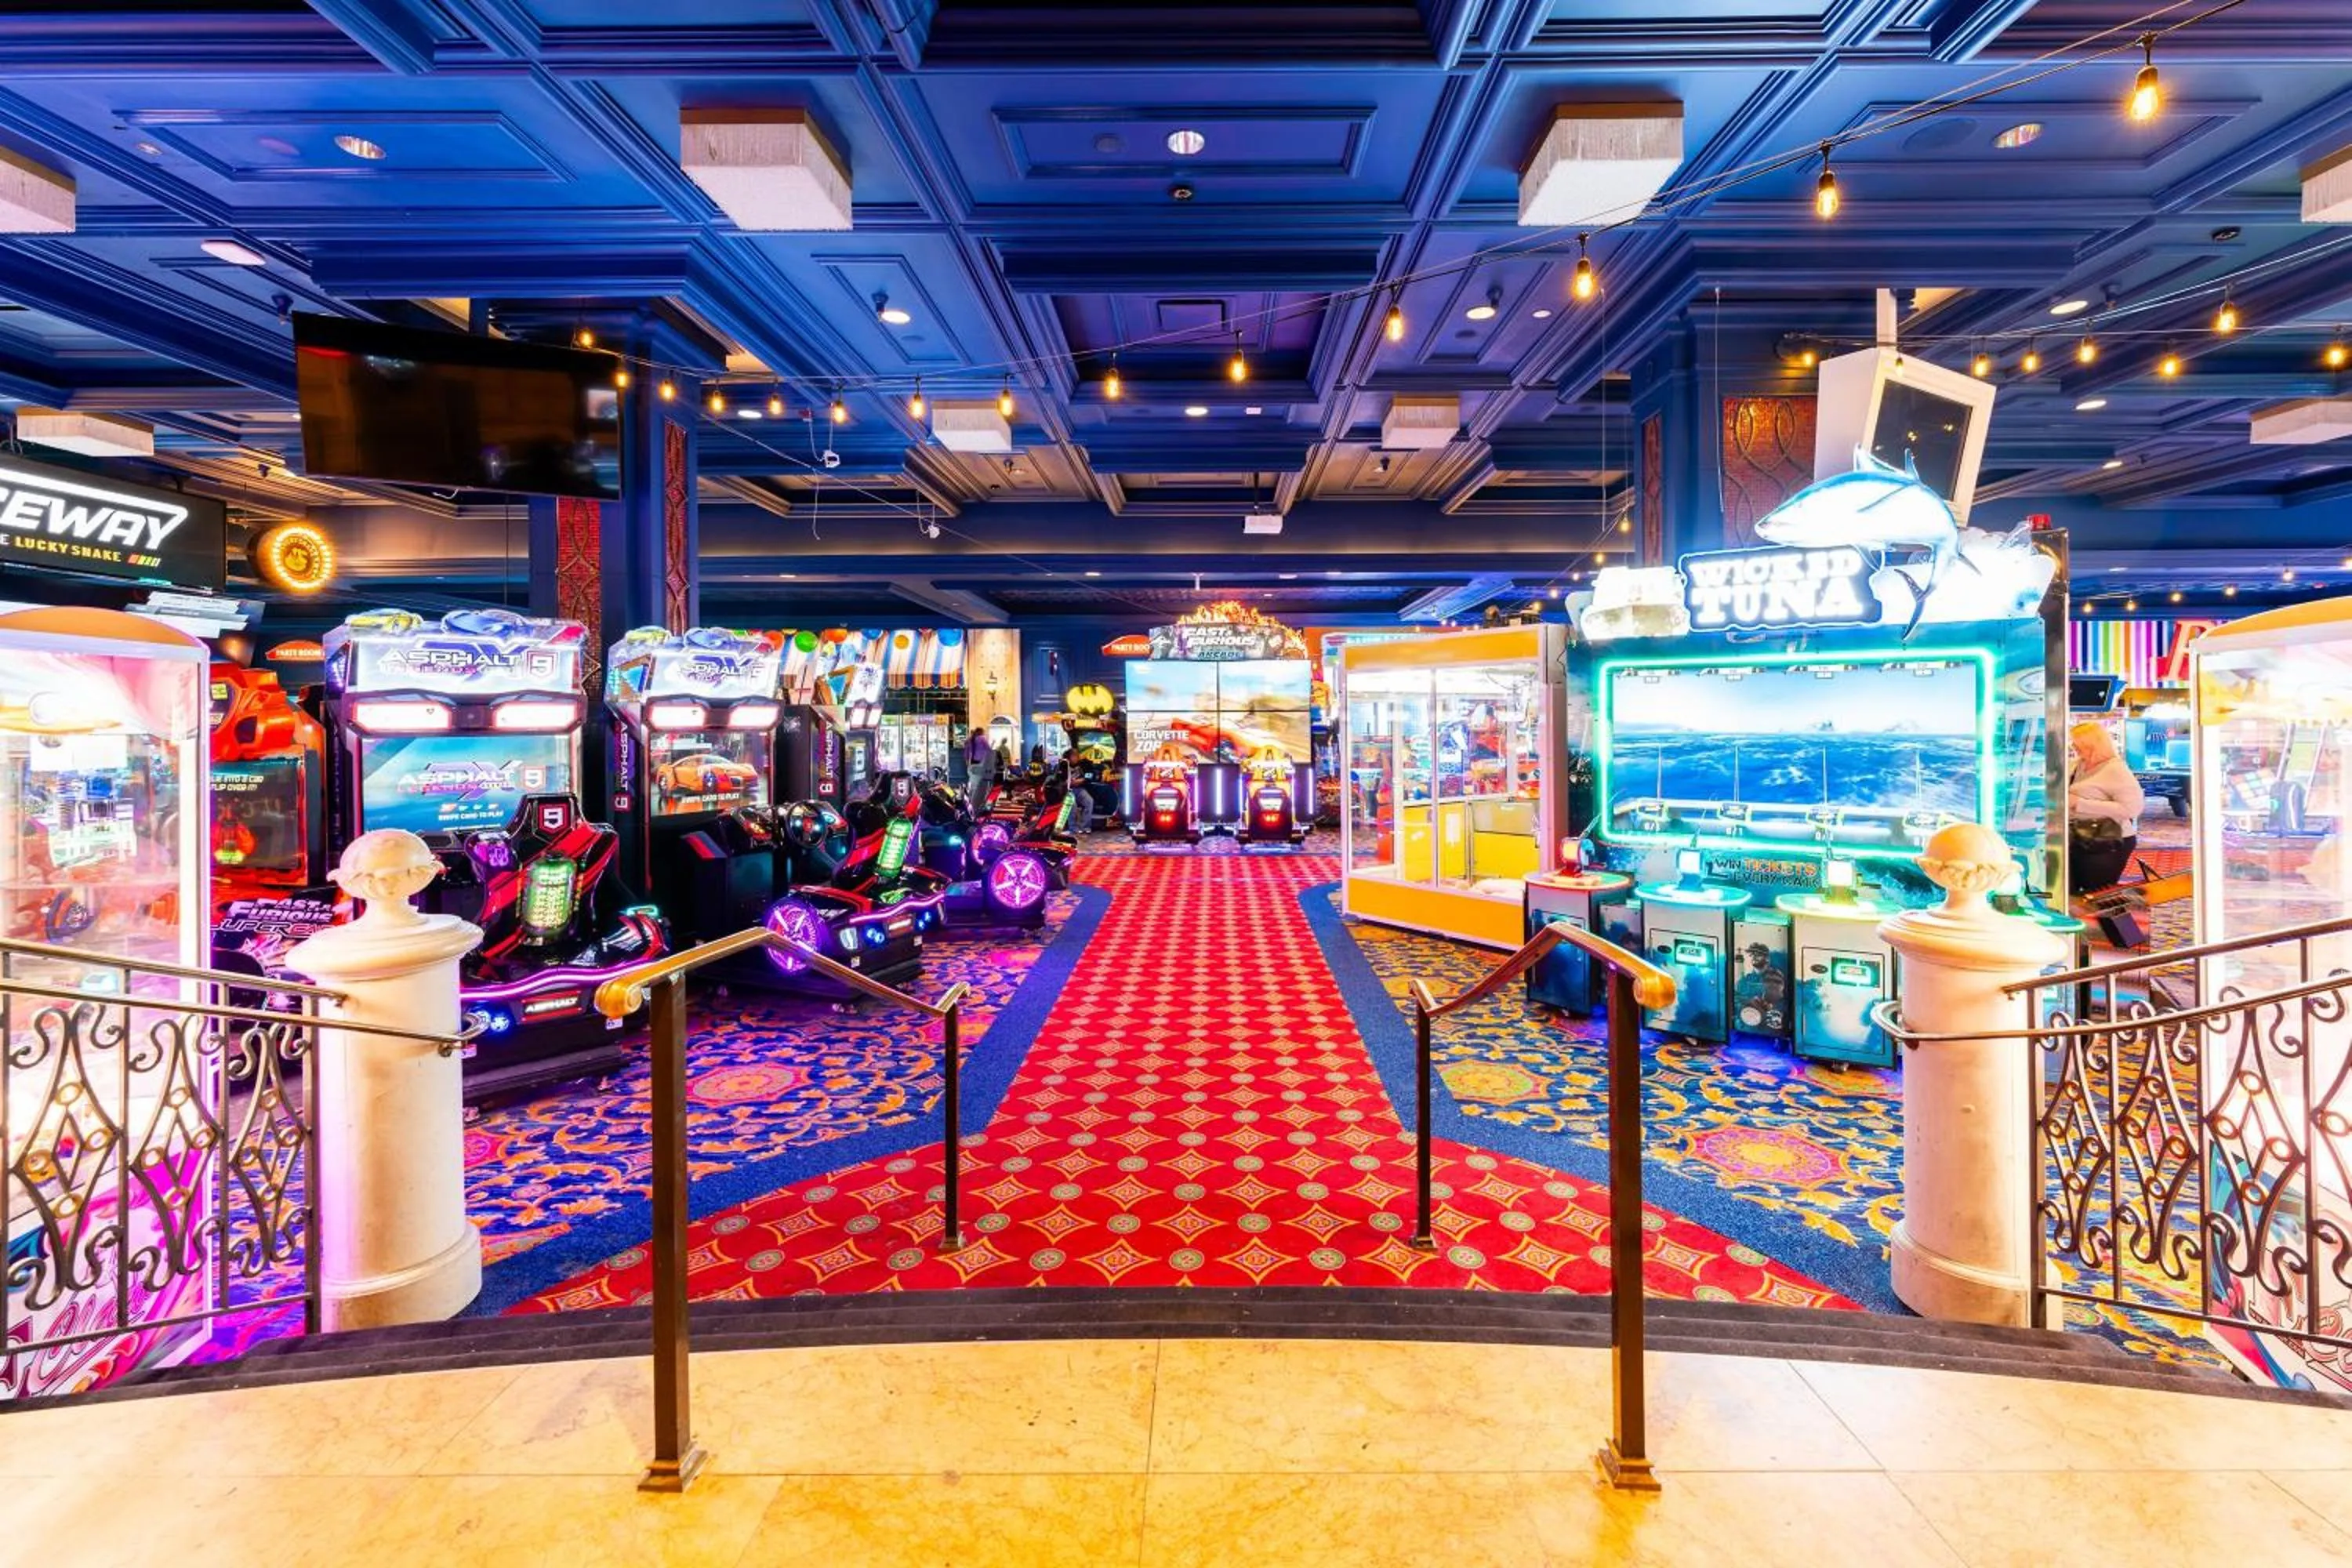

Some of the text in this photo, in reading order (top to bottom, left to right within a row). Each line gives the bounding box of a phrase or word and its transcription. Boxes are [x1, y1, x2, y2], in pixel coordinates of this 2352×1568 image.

[0, 486, 180, 550] EWAY
[14, 536, 69, 554] LUCKY
[71, 545, 122, 562] SNAKE
[1689, 550, 1863, 586] WICKED
[1690, 576, 1864, 623] TUNA
[1181, 627, 1224, 637] FAST
[1111, 644, 1150, 652] PARTY ROO
[1187, 636, 1256, 646] FURIOUS
[379, 648, 523, 666] ASPHALT
[1134, 730, 1190, 740] CORVETTE
[825, 722, 833, 779] ASPHALT
[397, 768, 516, 785] ASPHALT
[615, 797, 628, 808] 9
[1715, 857, 1817, 877] WIN TICKETS
[1733, 872, 1777, 884] EVERY
[227, 901, 333, 922] FURIOUS
[256, 898, 321, 910] FAST
[524, 996, 578, 1013] ASPHALT
